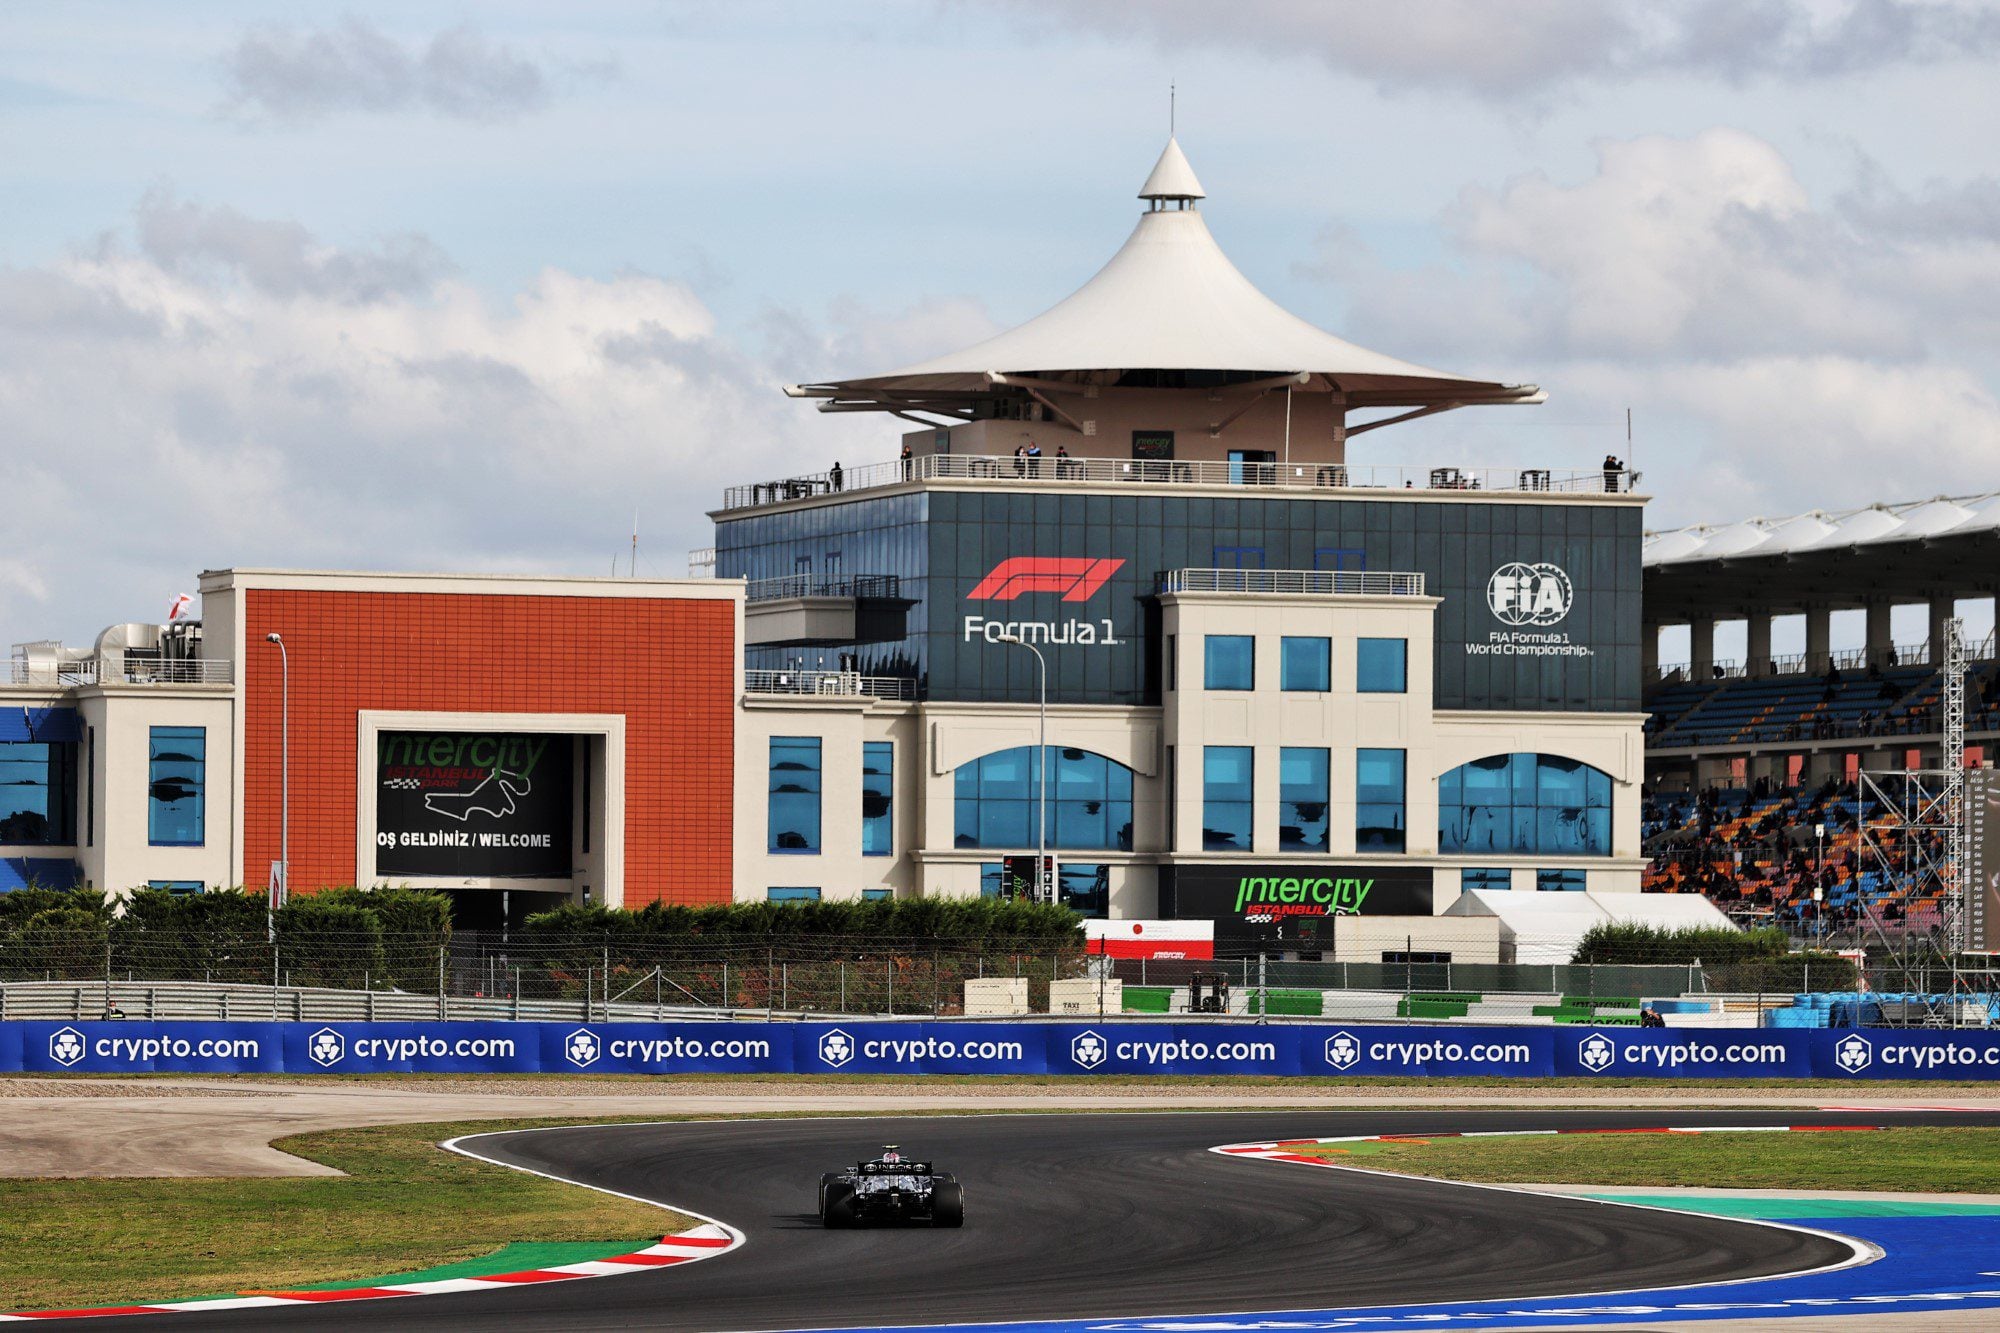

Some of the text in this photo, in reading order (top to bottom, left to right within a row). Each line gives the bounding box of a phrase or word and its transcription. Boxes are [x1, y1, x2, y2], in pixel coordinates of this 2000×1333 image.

[964, 615, 1096, 644] Formula
[1100, 618, 1118, 645] 1
[1489, 632, 1570, 644] FIA Formula 1
[1465, 643, 1501, 655] World
[1503, 643, 1588, 658] Championship
[400, 830, 469, 847] GELDİNİZ
[479, 833, 551, 847] WELCOME
[1246, 904, 1326, 916] ISTANBUL
[95, 1035, 259, 1060] crypto.com
[354, 1036, 515, 1060] crypto.com
[610, 1036, 769, 1061] crypto.com
[863, 1037, 1022, 1062] crypto.com
[1116, 1039, 1275, 1064] crypto.com
[1369, 1040, 1530, 1065] crypto.com
[1624, 1042, 1786, 1067] crypto.com
